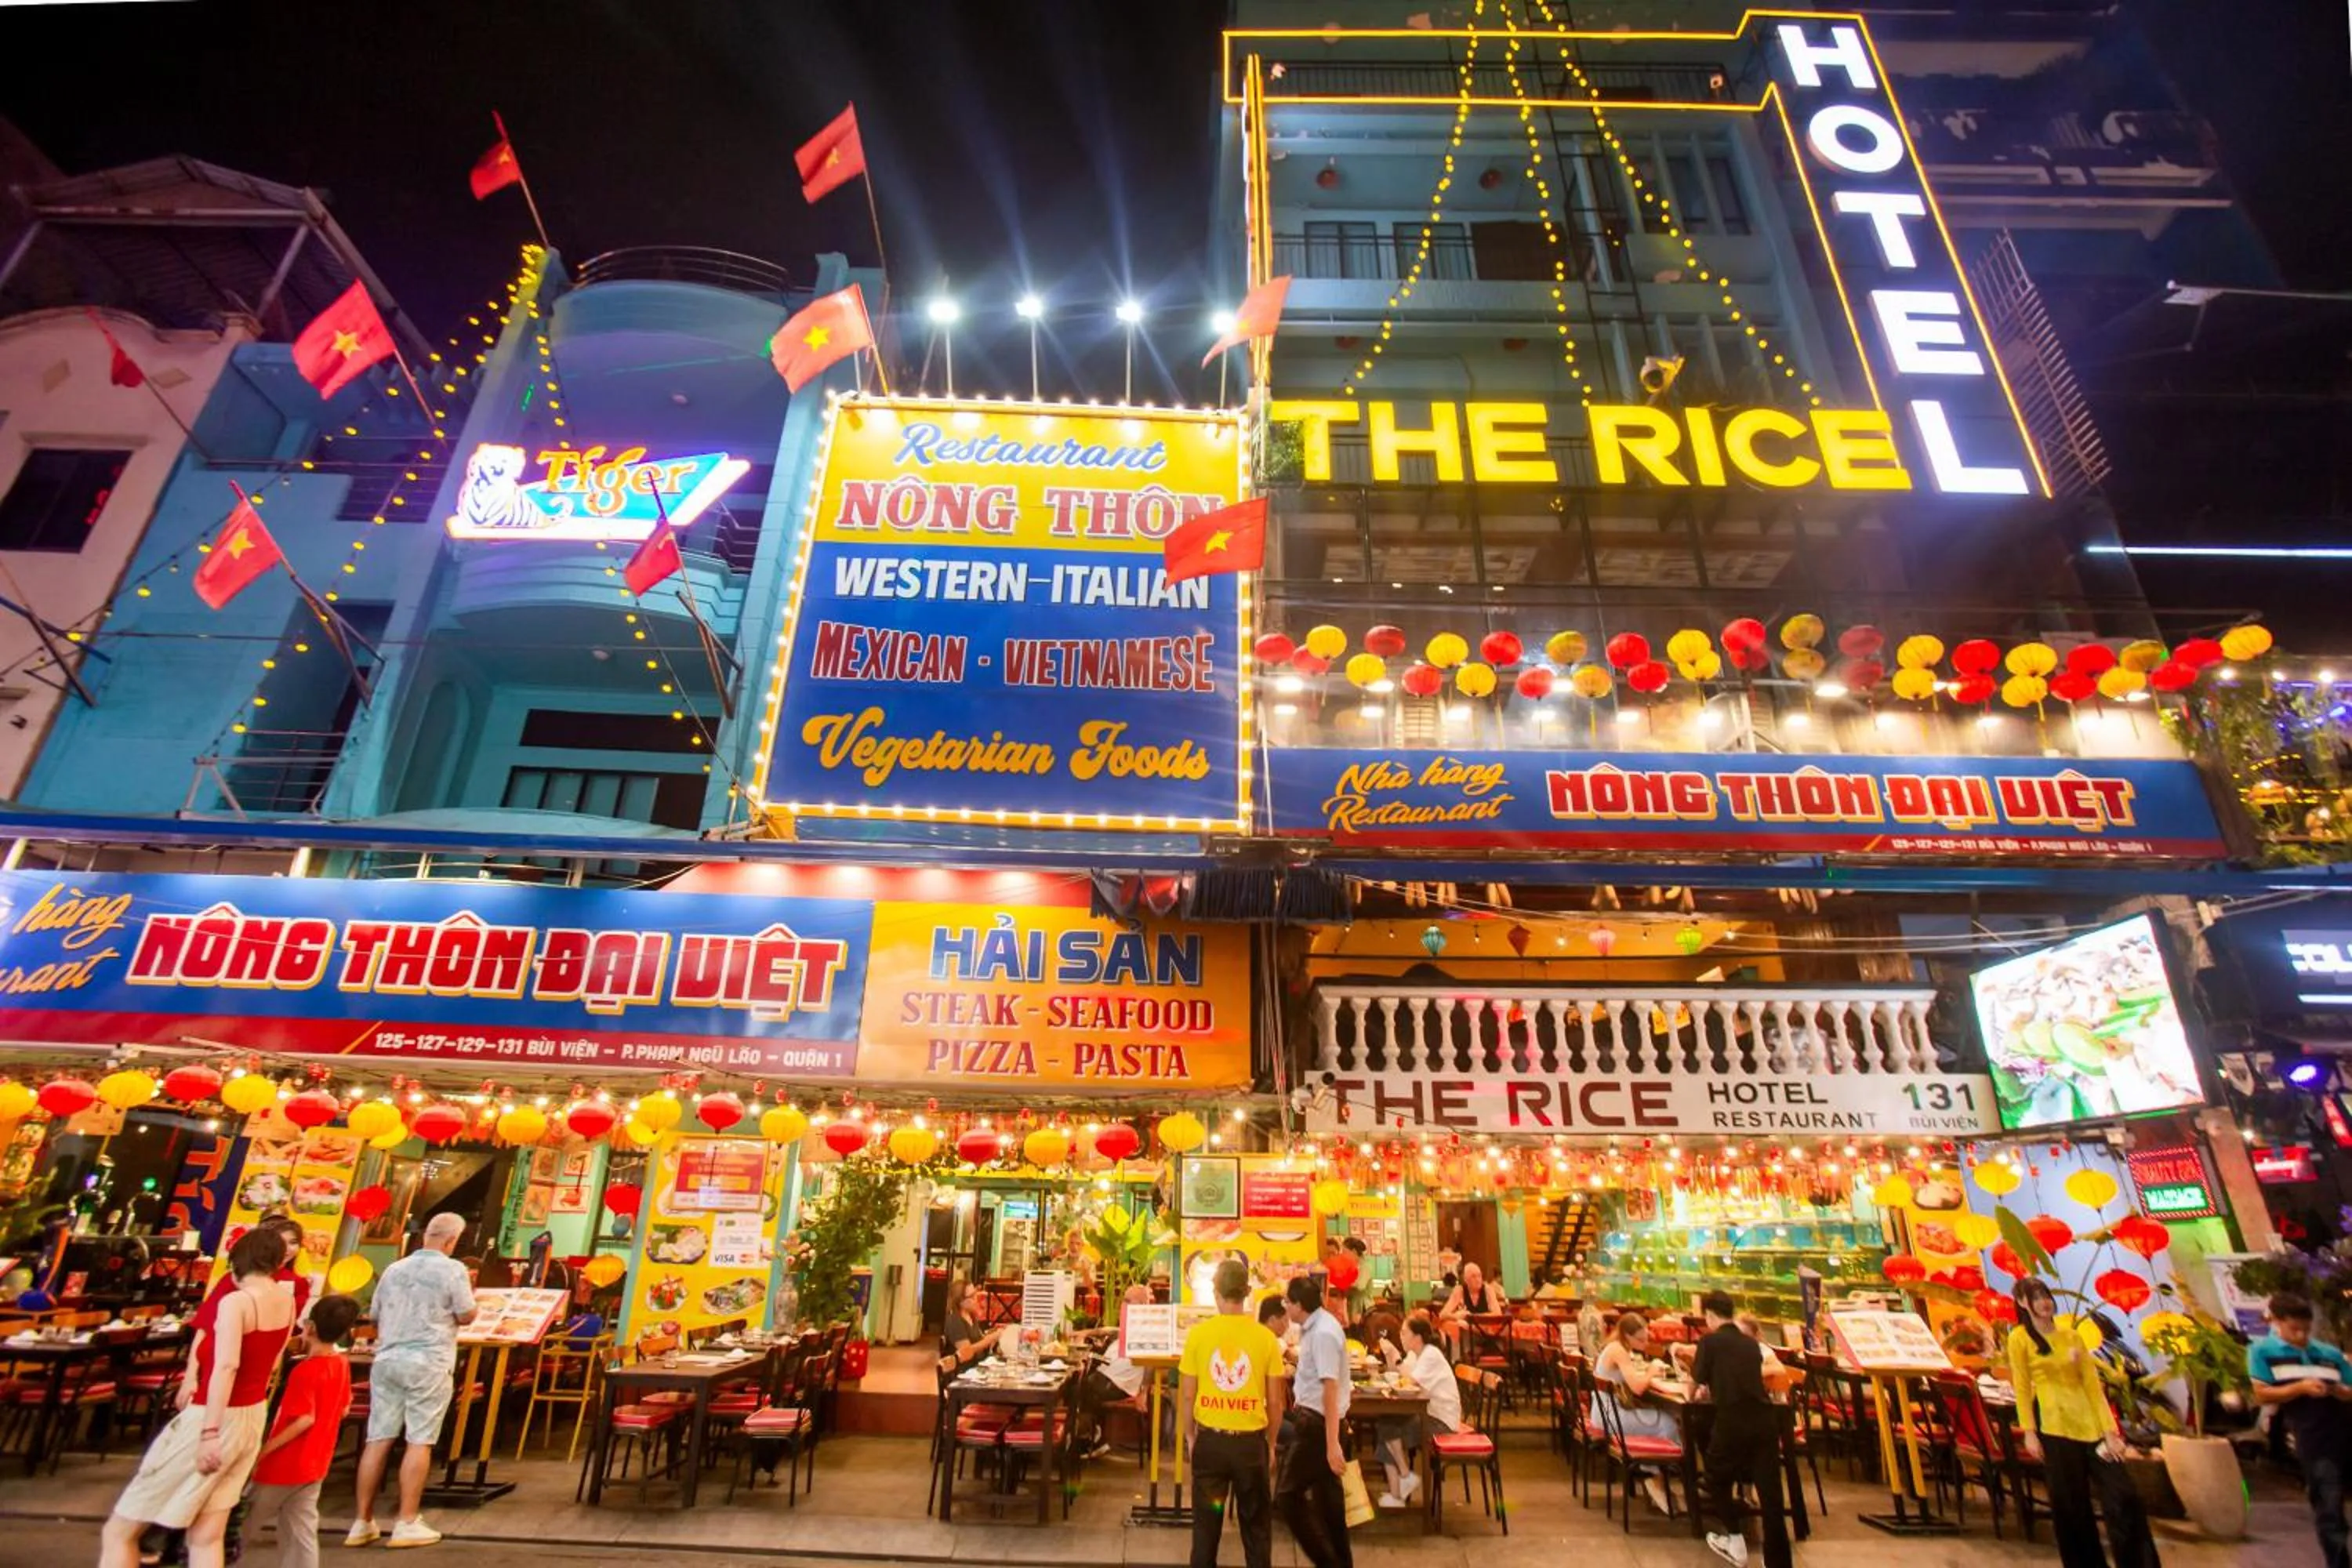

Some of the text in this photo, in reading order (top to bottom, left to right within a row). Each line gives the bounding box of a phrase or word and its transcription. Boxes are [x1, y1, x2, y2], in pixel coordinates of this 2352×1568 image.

[1777, 24, 2029, 495] HOTEL
[895, 423, 1169, 470] Restaurant
[1271, 400, 1912, 490] THE RICE
[536, 445, 696, 516] Tiger
[835, 475, 1019, 535] NÔNG
[810, 621, 1215, 692] MEXICAN VIETNAMESE
[801, 706, 1210, 786] Vegetarian Foods
[1336, 755, 1509, 798] Nhà hàng
[1545, 761, 1719, 820] NÔNG
[1716, 764, 1885, 823] THÔN
[1321, 793, 1515, 834] Restaurant
[12, 883, 132, 950] hàng
[125, 901, 336, 991] NÔNG
[339, 909, 539, 999] THÔN
[929, 913, 1048, 984] HẢI
[901, 992, 1022, 1028] STEAK
[1047, 996, 1214, 1035] SEAFOOD
[526, 1035, 556, 1057] BÙI
[926, 1039, 1039, 1077] PIZZA
[1073, 1042, 1192, 1080] PASTA
[1327, 1079, 1679, 1127] THE RICE
[1708, 1081, 1828, 1105] HOTEL
[1902, 1083, 1976, 1111] 131
[1713, 1110, 1878, 1129] RESTAURANT
[713, 1254, 735, 1264] VISA
